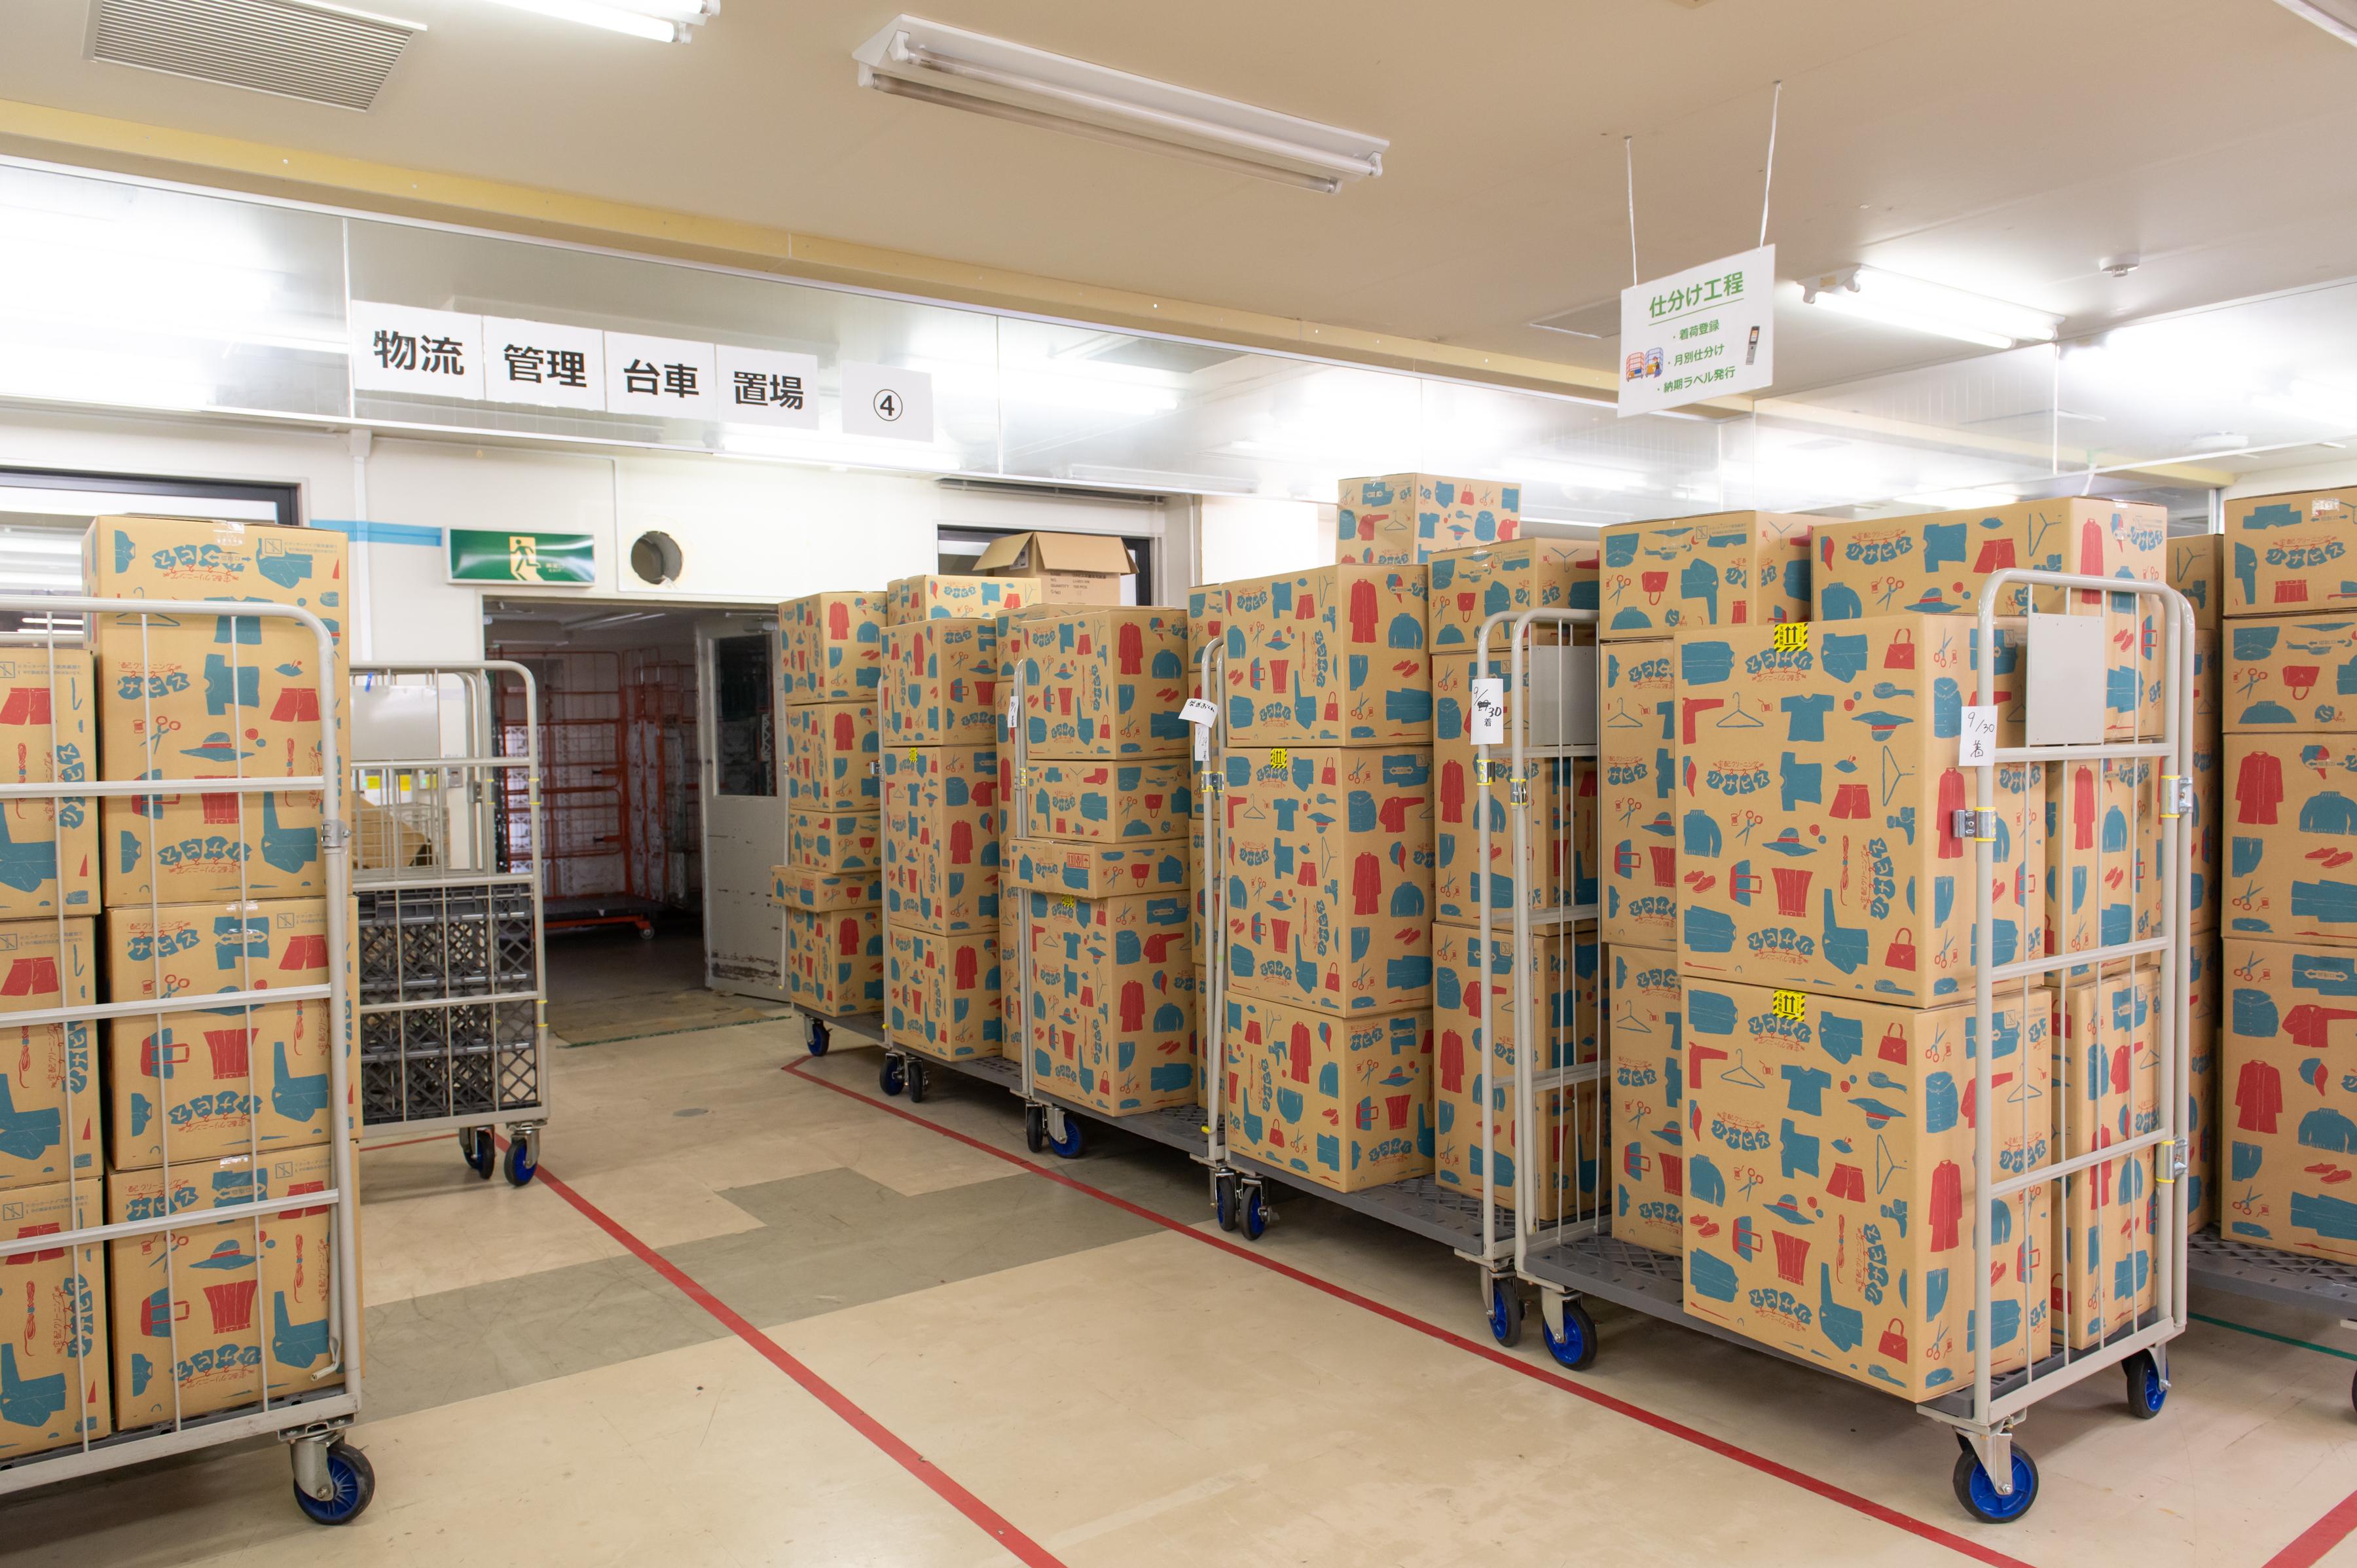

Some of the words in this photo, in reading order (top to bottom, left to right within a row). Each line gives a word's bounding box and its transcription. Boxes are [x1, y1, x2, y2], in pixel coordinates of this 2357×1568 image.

[1649, 271, 1744, 318] 仕分け工程
[373, 330, 464, 375] 物流
[503, 344, 587, 388] 管理
[623, 359, 699, 398] 台車
[733, 371, 804, 410] 置場
[1850, 539, 1911, 560] リナビス
[2271, 545, 2343, 565] リナビス
[1747, 651, 1811, 672] リナビス
[120, 675, 188, 695] ナビス
[1484, 718, 1493, 727] 着
[1968, 712, 1995, 734] 9/30
[1608, 765, 1646, 783] ナビス
[1709, 771, 1768, 792] リナビス
[1873, 840, 1893, 916] リナビス
[128, 921, 183, 931] 配クリーニング
[128, 931, 198, 957] ナビス
[1749, 930, 1814, 955] リナビス
[1351, 1029, 1382, 1048] ナビス
[1618, 1068, 1655, 1085] ナビス
[1713, 1122, 1770, 1148] リナビス
[1866, 1225, 1887, 1302] リナビス
[1750, 1290, 1810, 1323] リナビス
